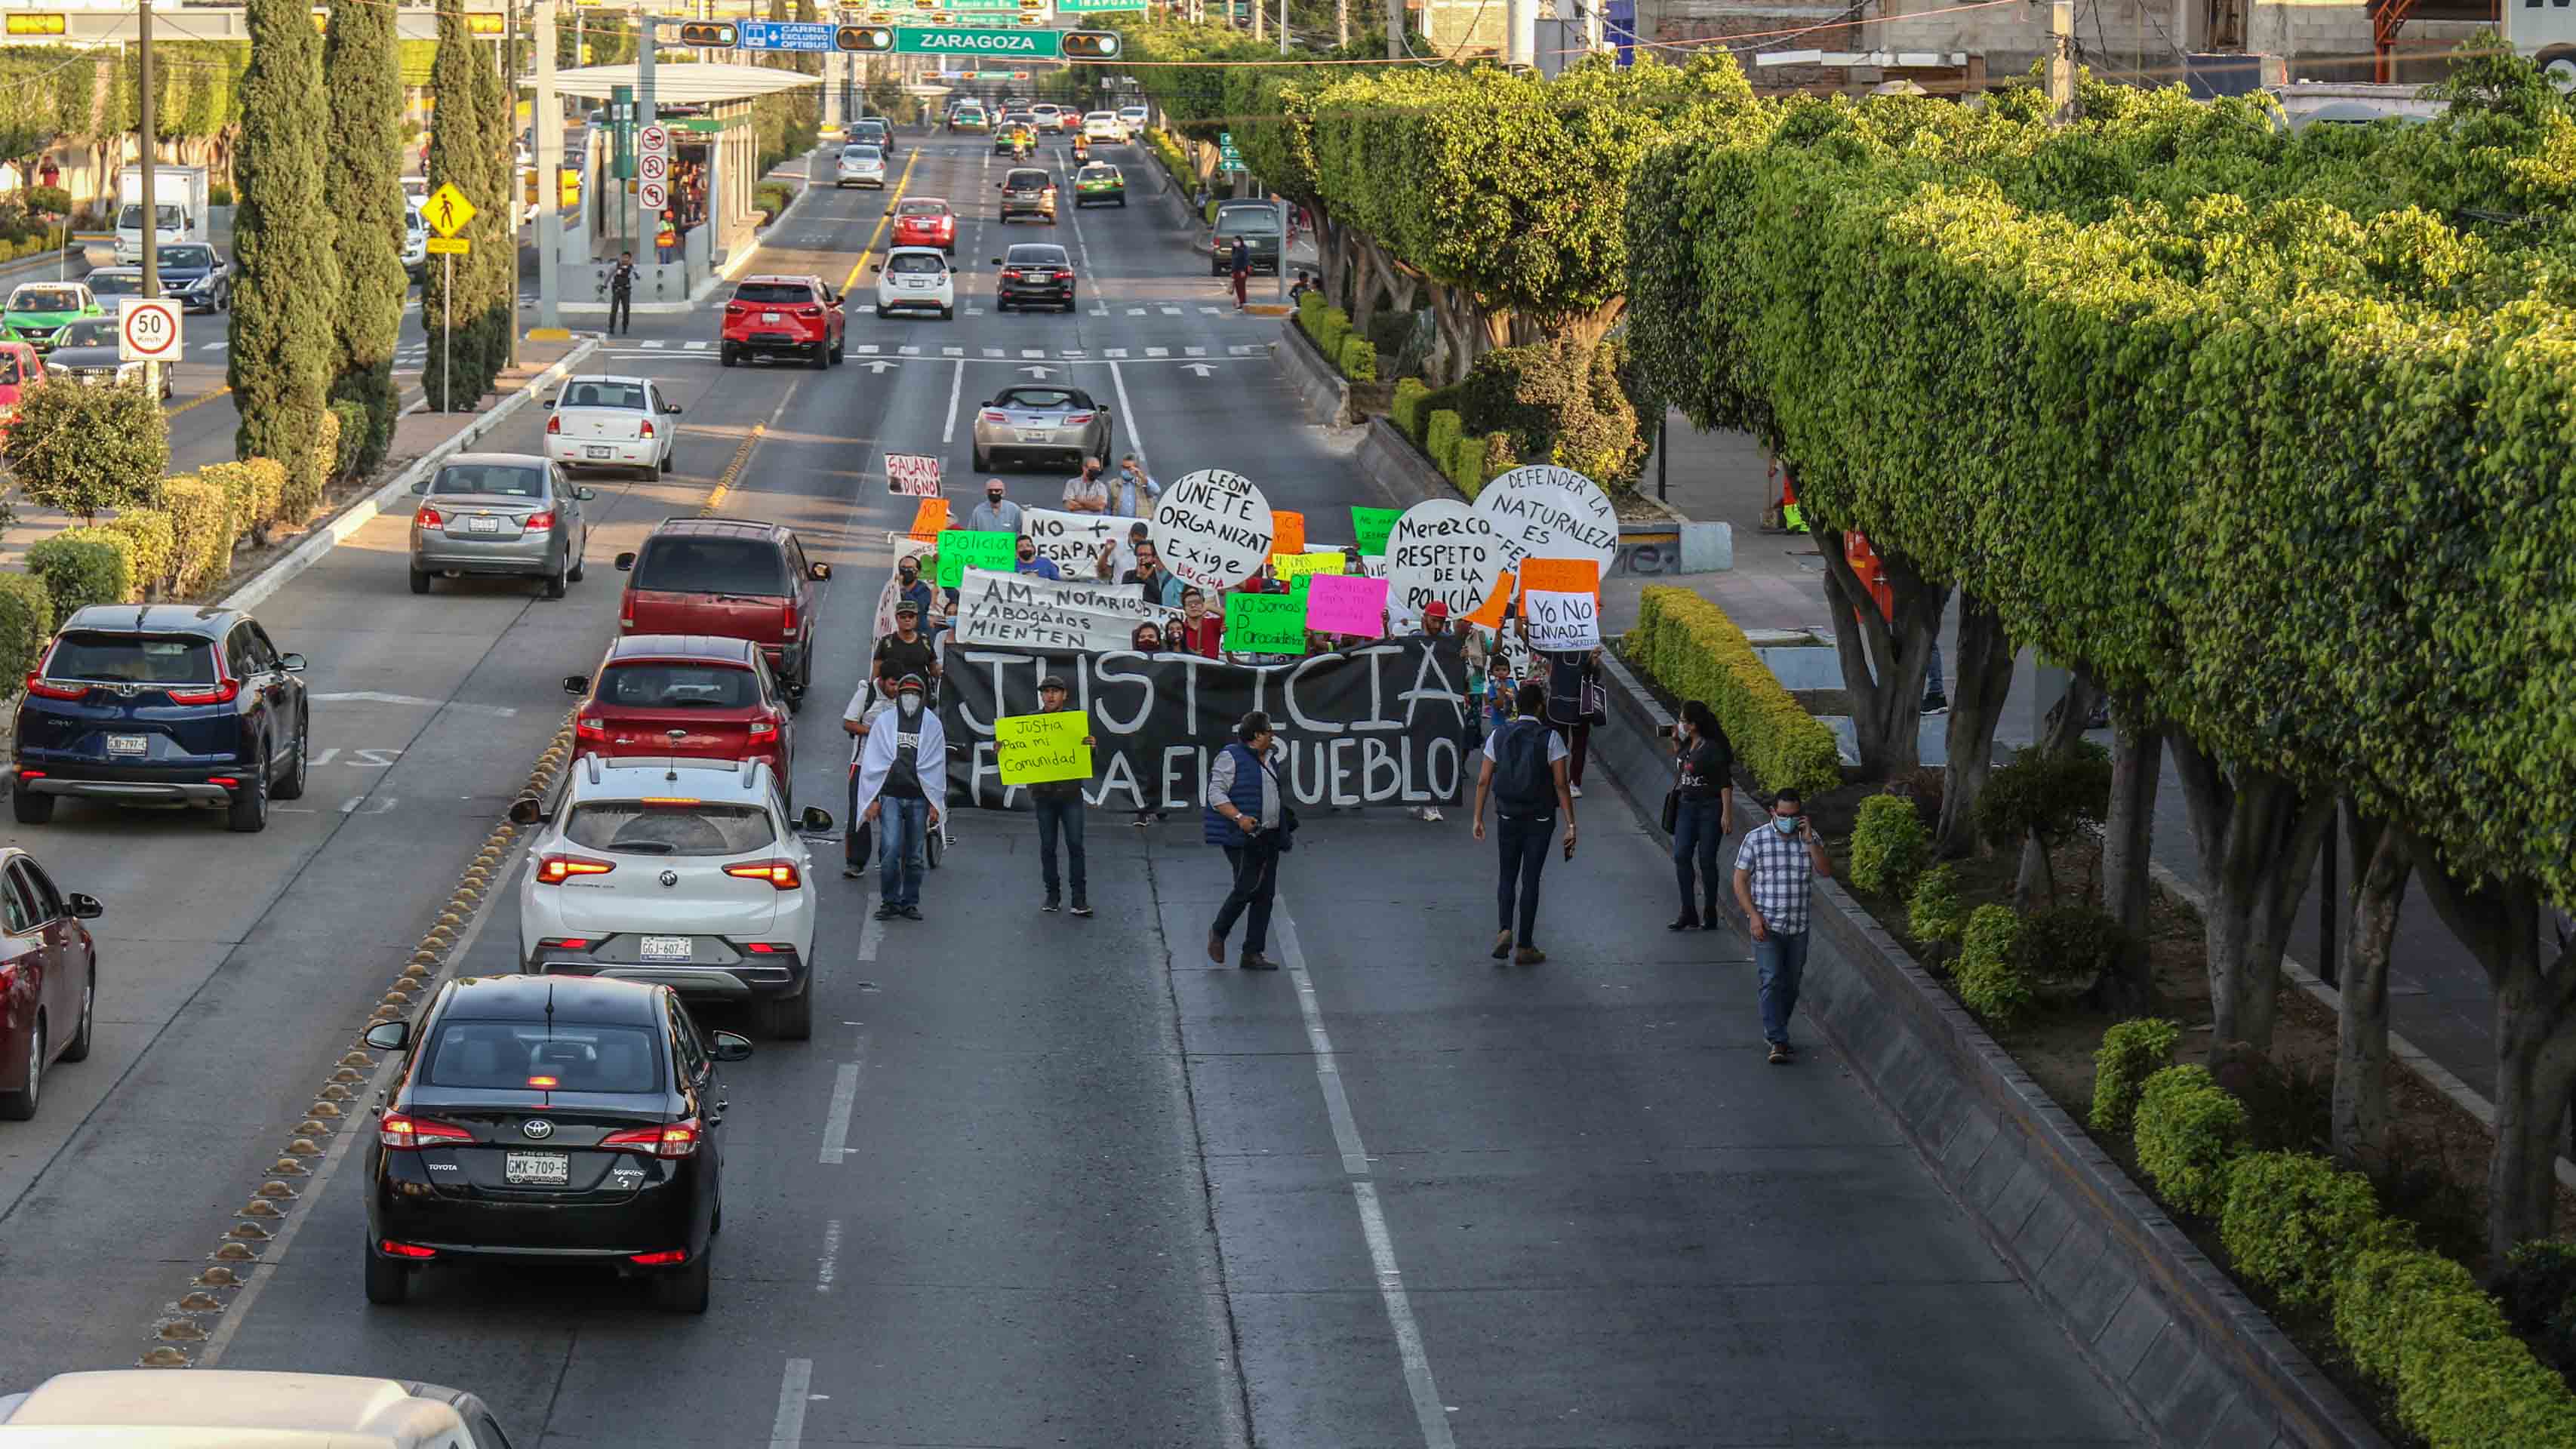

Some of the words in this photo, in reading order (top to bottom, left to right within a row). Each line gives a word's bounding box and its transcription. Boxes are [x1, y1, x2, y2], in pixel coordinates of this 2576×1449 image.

[780, 25, 829, 33] CARRIL
[780, 41, 829, 49] OPTIBUS
[920, 34, 1036, 50] ZARAGOZA
[138, 314, 161, 334] 50
[888, 456, 939, 477] SALARIO
[902, 478, 937, 496] DIGNO
[1208, 469, 1252, 496] LEÓN
[1509, 469, 1587, 496] DEFENDER
[1588, 496, 1609, 518] LA
[1031, 519, 1064, 537] NO
[1491, 494, 1617, 554] NATURALEZA
[1522, 525, 1550, 544] ES
[1396, 545, 1486, 568] RESPETO
[1434, 568, 1454, 582] DE
[1461, 568, 1484, 585] LA
[970, 604, 980, 617] Y
[968, 620, 1085, 648] MIENTEN
[1528, 623, 1588, 640] INVADI
[959, 641, 1466, 736] JUSTICIA
[1004, 749, 1076, 773] Comunidad
[642, 942, 689, 955] GGJ-607-C
[508, 1158, 568, 1176] GMX-709-B
